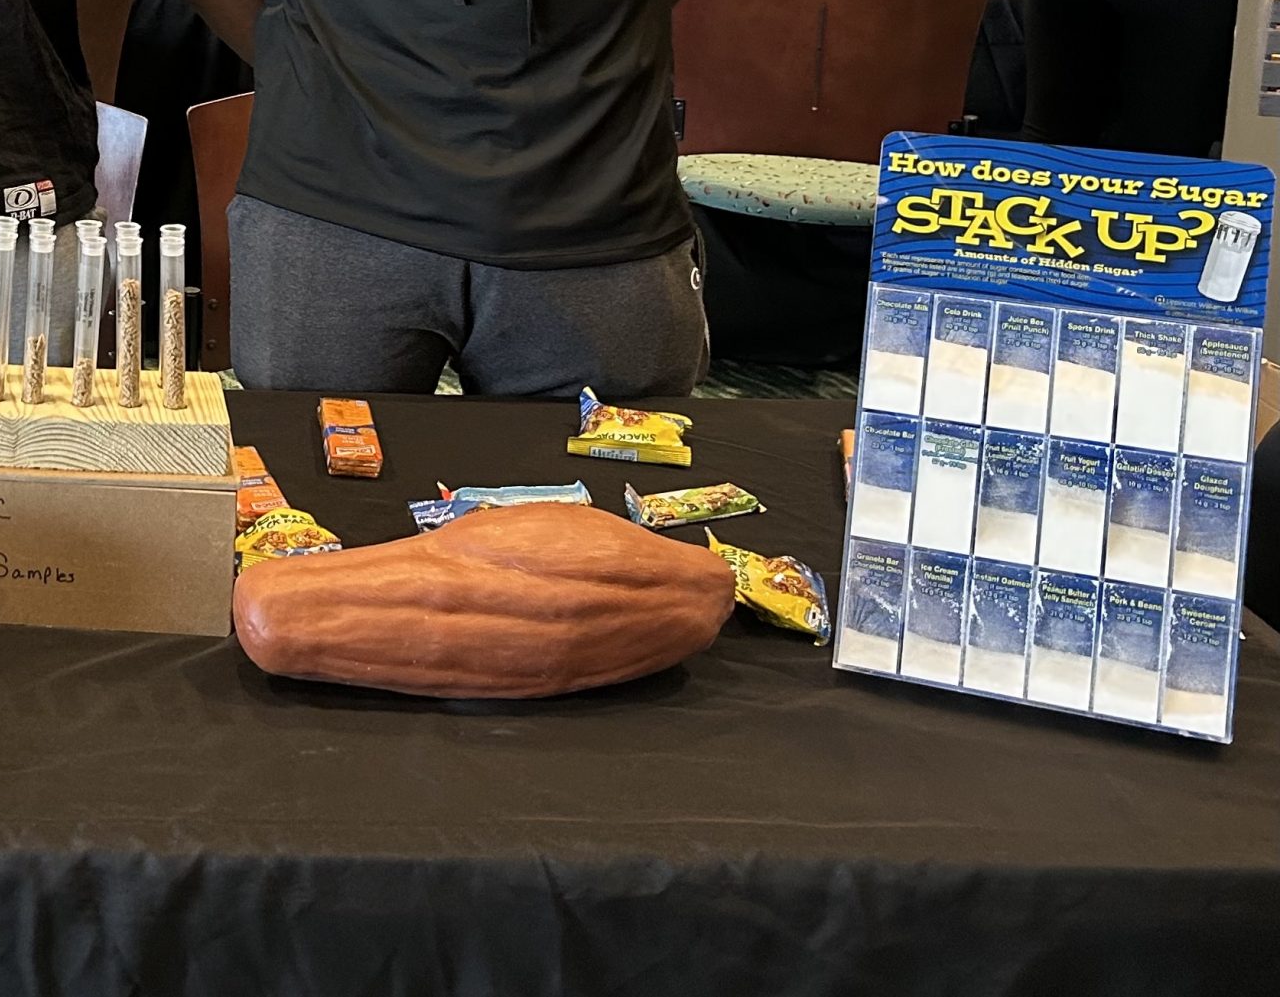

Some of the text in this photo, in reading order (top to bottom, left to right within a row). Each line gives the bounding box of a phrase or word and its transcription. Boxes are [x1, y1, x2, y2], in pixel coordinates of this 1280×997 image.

[888, 151, 1268, 209] How does your Sugar
[892, 188, 1217, 263] STACK UP?
[953, 248, 1018, 264] Amounts
[1020, 256, 1037, 266] of
[1038, 257, 1091, 271] Hidden
[876, 299, 929, 312] Chocolate Milk
[944, 307, 982, 318] Cola Drink
[1008, 315, 1044, 326] Juice Box
[1023, 325, 1049, 335] Punch)
[1067, 322, 1115, 335] Sports Drink
[1134, 330, 1182, 343] Thick Shake
[1202, 339, 1249, 352] Applesauce
[1199, 347, 1250, 360] (Sweetened)
[864, 426, 916, 439] Chocolate Bar
[1060, 454, 1076, 463] Fruit
[1077, 456, 1101, 467] Yogurt
[1116, 461, 1144, 473] Gelatin
[1063, 463, 1096, 475] (Low-Fat)
[1199, 474, 1228, 486] Glazed
[1194, 482, 1233, 495] Doughnut
[856, 552, 899, 566] Granola Bar
[921, 563, 959, 576] Ice Cream
[1001, 576, 1032, 589] Oatmeal
[1042, 584, 1090, 599] Peanut Butter
[1043, 593, 1094, 607] Jelly Sandwich
[1110, 596, 1128, 606] Pork
[1137, 600, 1163, 612] Beans
[1181, 607, 1226, 622] Sweetened
[1189, 618, 1216, 629] Cereal
